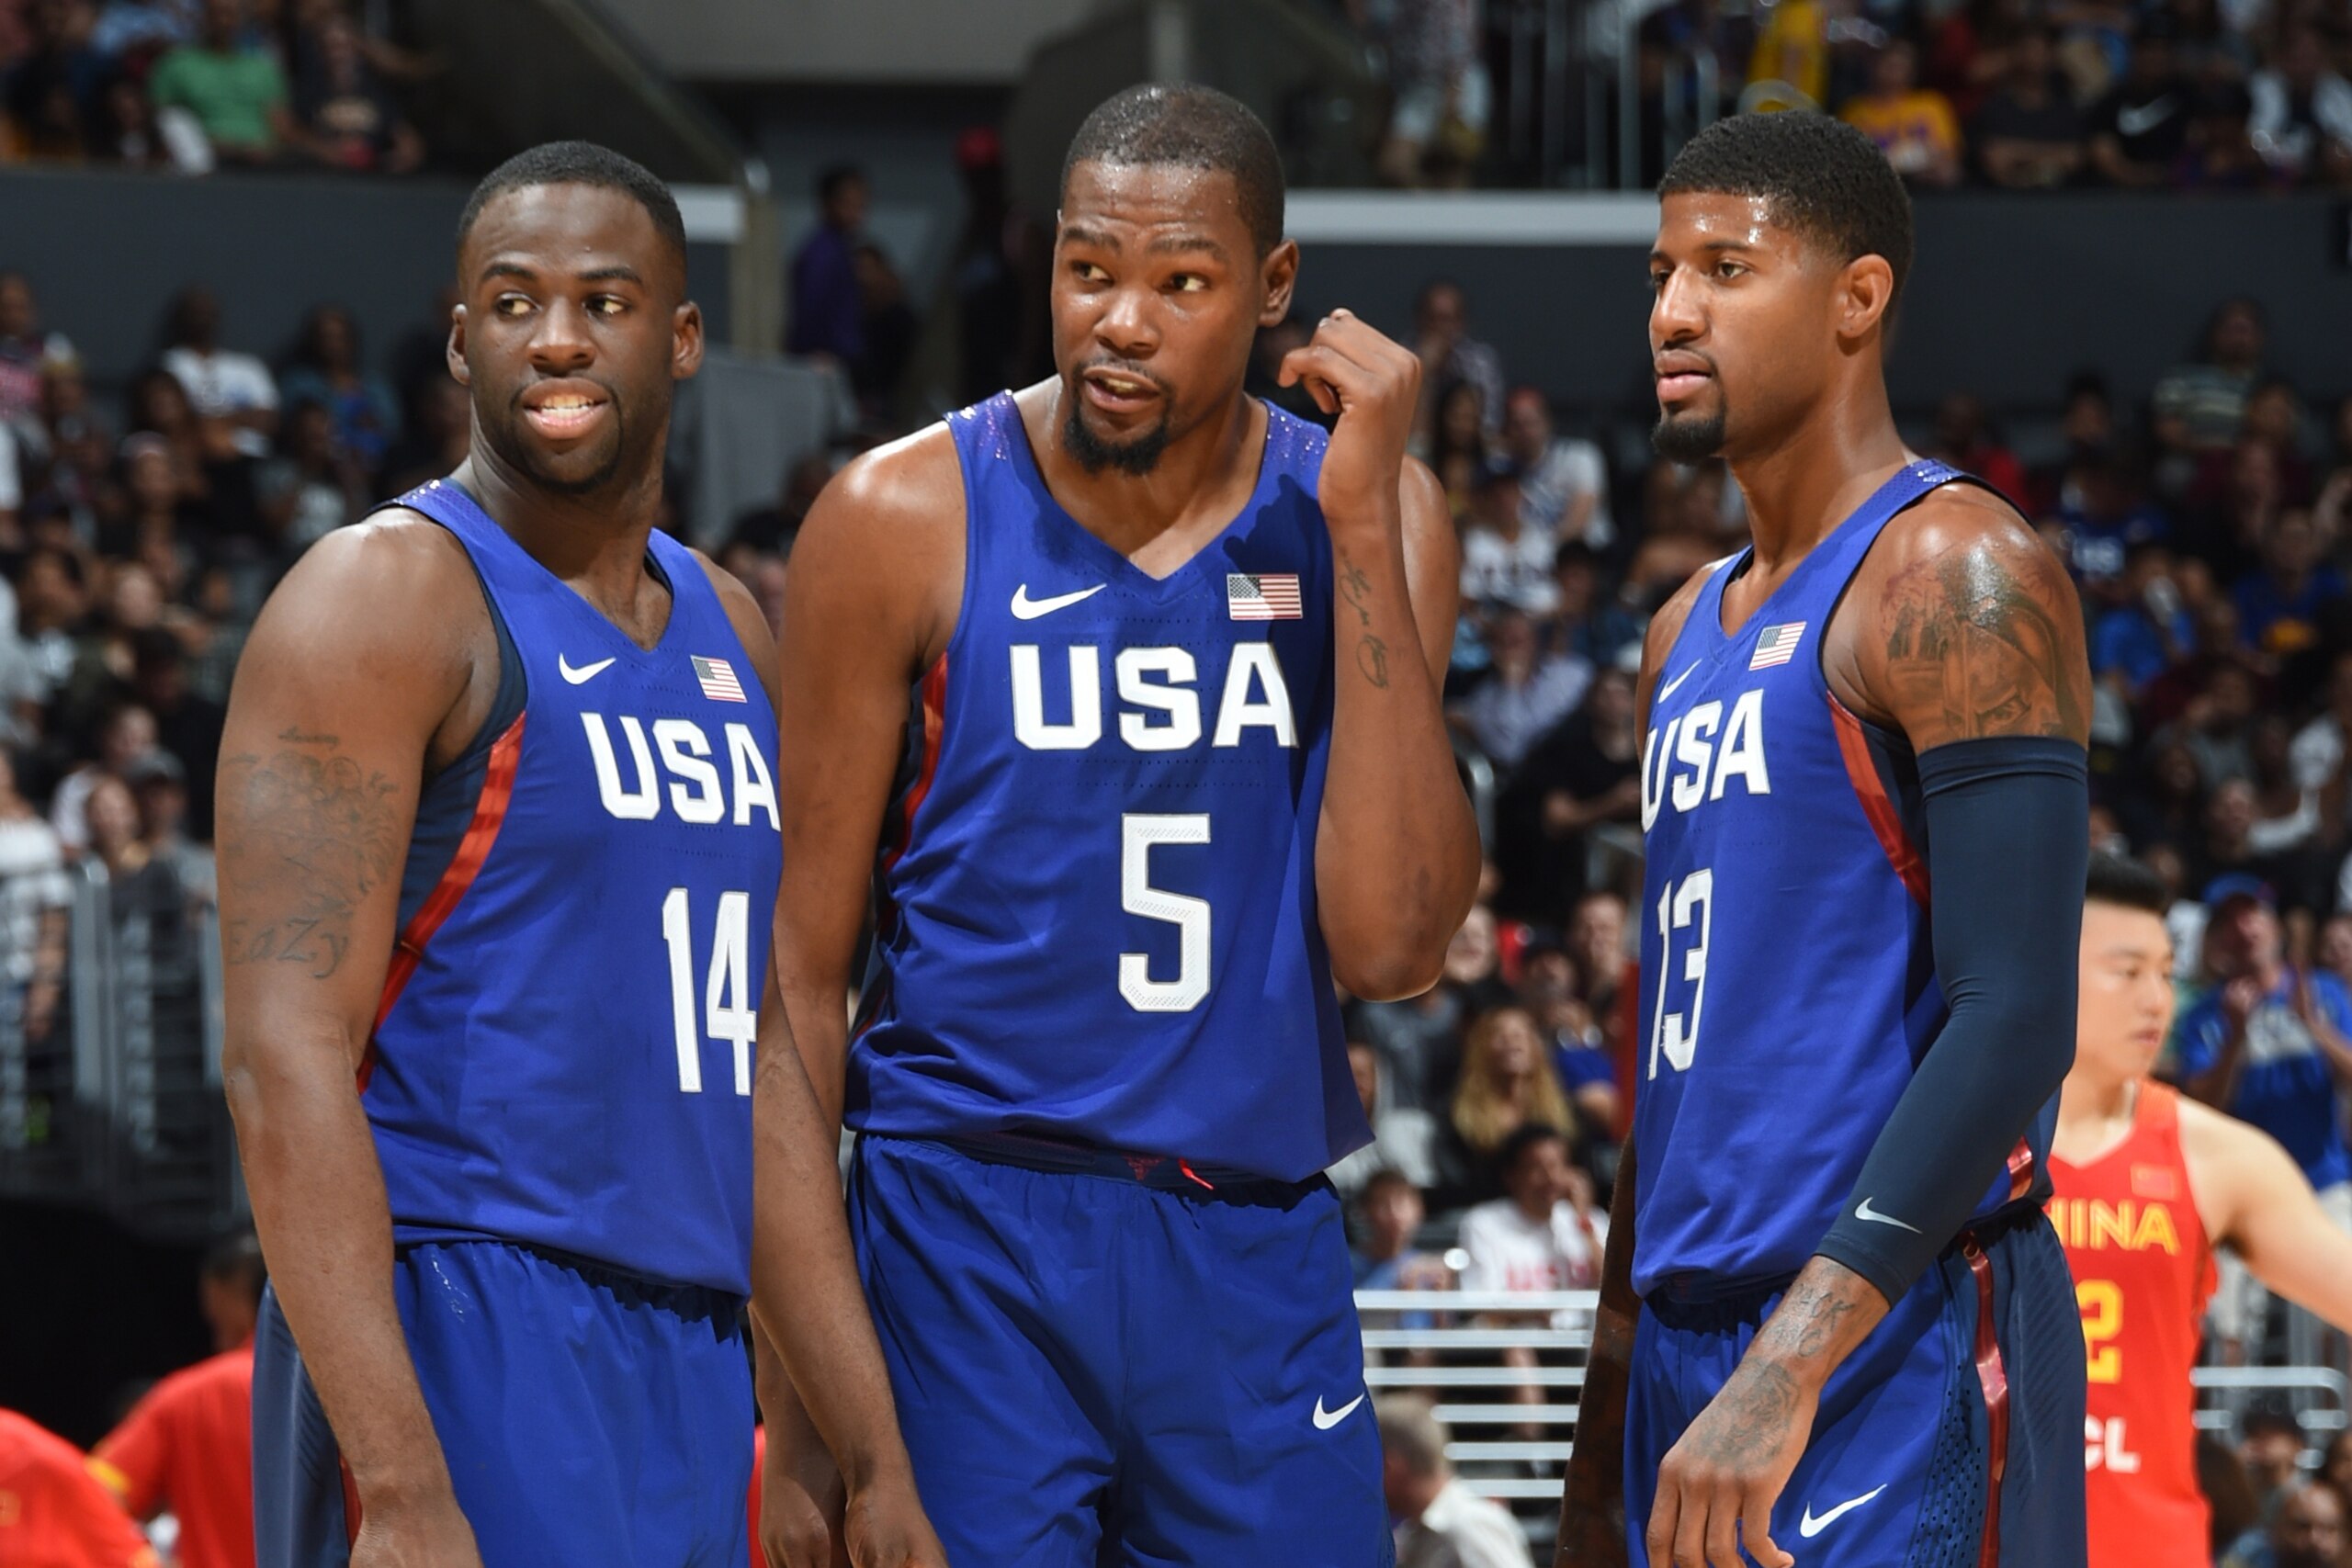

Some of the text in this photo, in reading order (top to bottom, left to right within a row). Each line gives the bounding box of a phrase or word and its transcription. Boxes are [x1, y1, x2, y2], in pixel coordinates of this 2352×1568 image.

[1009, 642, 1300, 752] USA
[1640, 688, 1771, 834] USA
[580, 711, 783, 832] USA
[1118, 812, 1212, 1012] 5
[1647, 867, 1713, 1081] 13
[662, 887, 757, 1097] 14
[2046, 1197, 2182, 1258] INA
